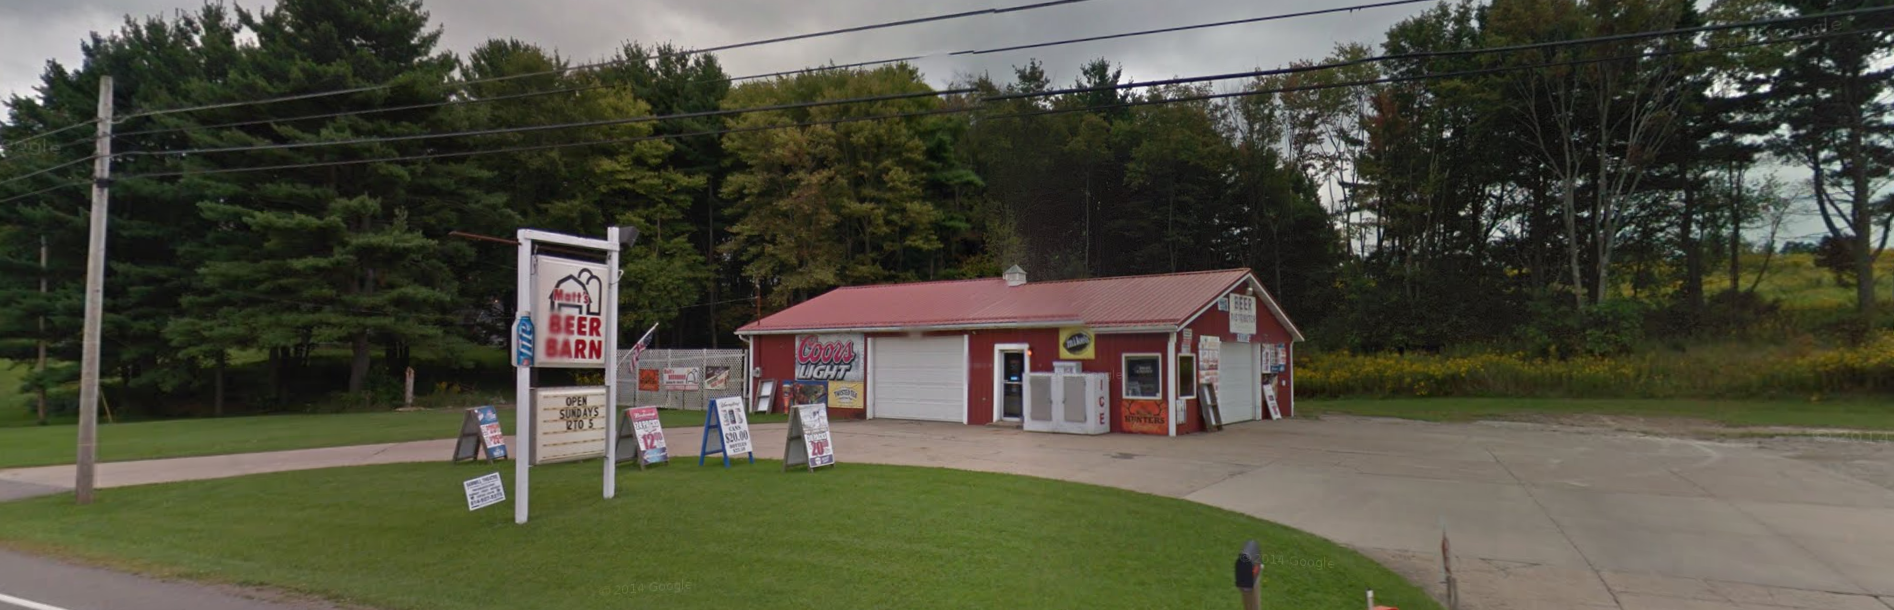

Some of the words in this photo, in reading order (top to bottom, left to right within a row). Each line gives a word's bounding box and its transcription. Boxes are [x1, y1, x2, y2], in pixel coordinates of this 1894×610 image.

[553, 288, 589, 305] Matt's
[1234, 295, 1252, 311] BEER
[549, 313, 602, 337] BEER
[545, 337, 602, 360] BARN
[797, 334, 856, 365] Coors
[797, 364, 852, 381] LIGHT
[565, 396, 587, 406] OPEN
[559, 406, 599, 420] SUNDAYS
[588, 419, 594, 429] 5
[725, 429, 749, 444] $20.00
